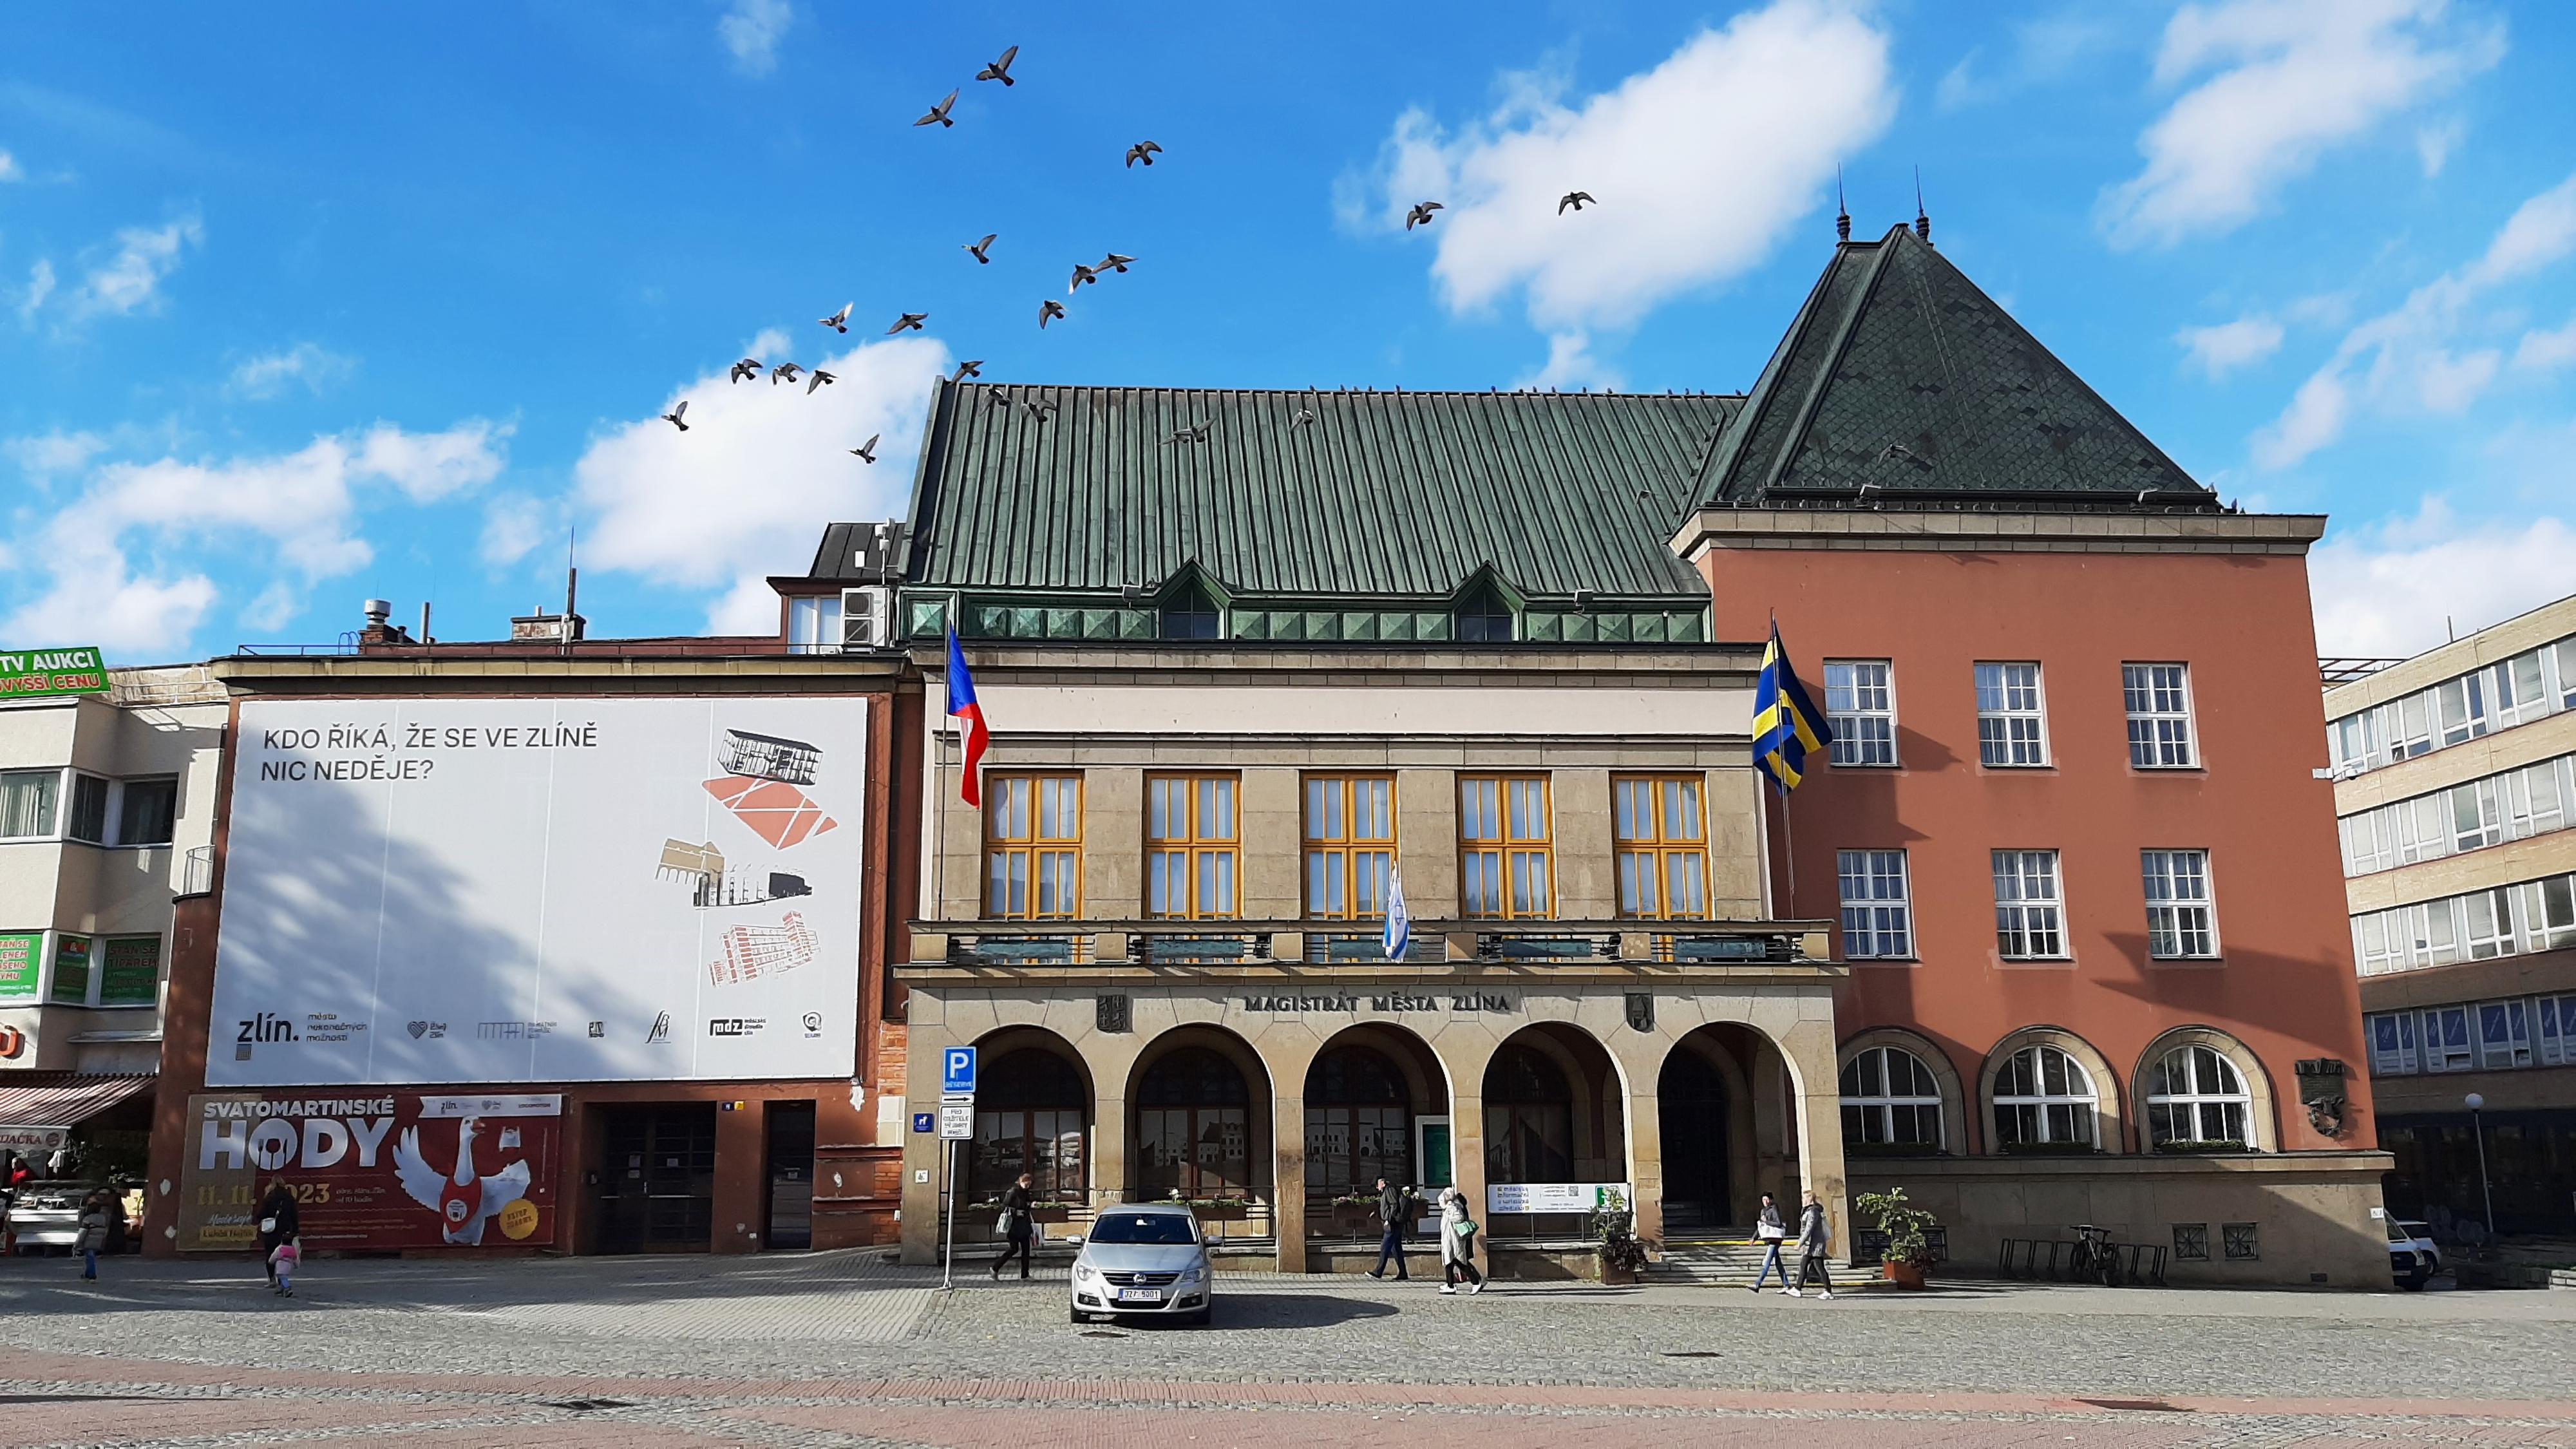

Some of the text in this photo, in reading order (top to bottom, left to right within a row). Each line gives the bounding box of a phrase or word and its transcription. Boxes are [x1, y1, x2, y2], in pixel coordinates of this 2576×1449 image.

[33, 651, 95, 670] AUKCI
[53, 674, 100, 689] CENU
[264, 722, 598, 752] KDO ŘÍKÁ, ŽE SE VE ZLÍNĚ
[261, 755, 433, 781] NIC NEDĚJE?
[1244, 990, 1510, 1012] MAGISTRÁT MĚSTA ZLÍNA
[237, 1013, 299, 1042] zlín.
[950, 1052, 969, 1079] P
[204, 1095, 394, 1118] SVATOMARTINSKÉ
[199, 1118, 395, 1171] HODY
